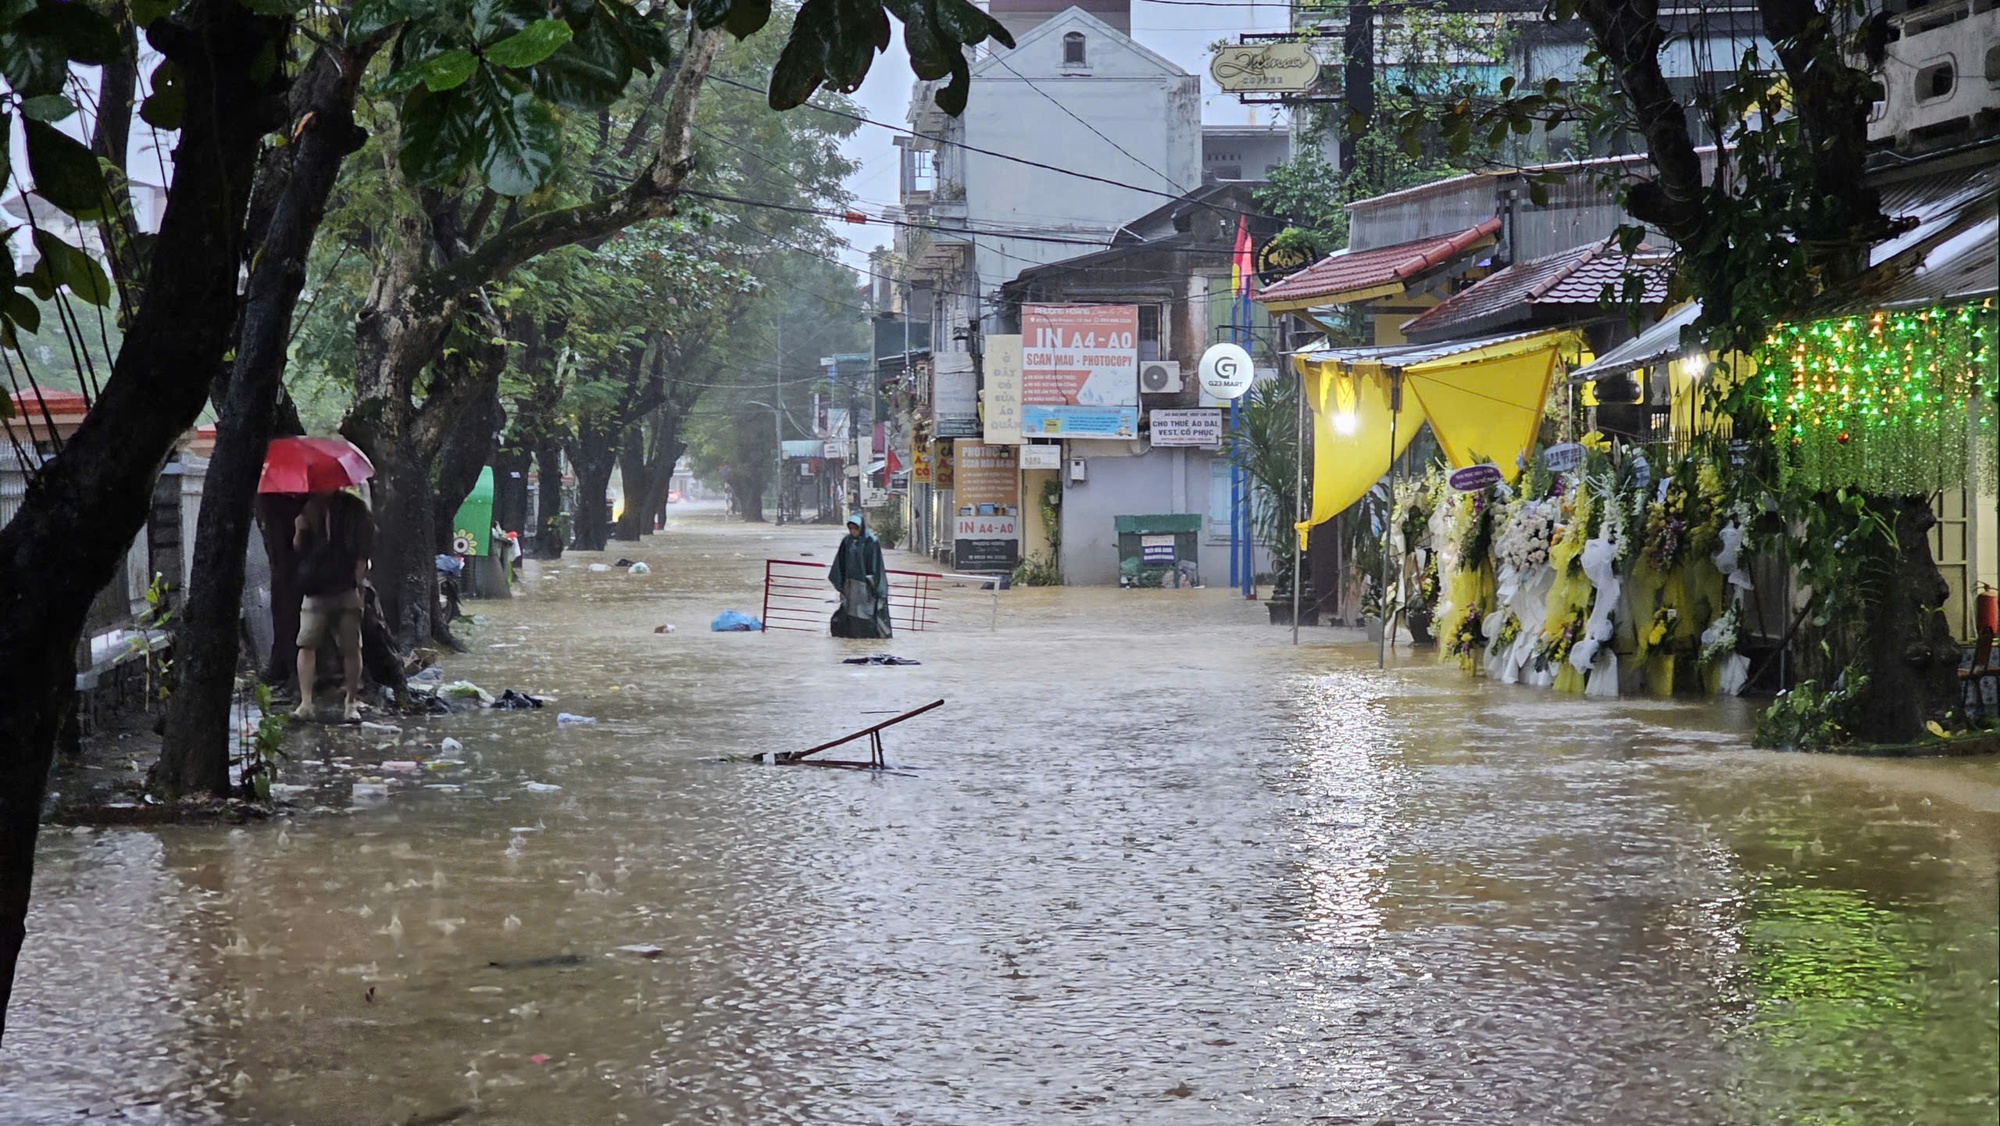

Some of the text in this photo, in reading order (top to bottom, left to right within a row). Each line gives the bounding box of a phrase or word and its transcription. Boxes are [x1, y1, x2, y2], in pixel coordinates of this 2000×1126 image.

[1036, 328, 1062, 348] IN
[1026, 353, 1052, 365] SCAN
[1082, 355, 1133, 366] PHOTOCOPY
[962, 447, 1015, 457] PHOTOCY
[960, 522, 974, 533] IN
